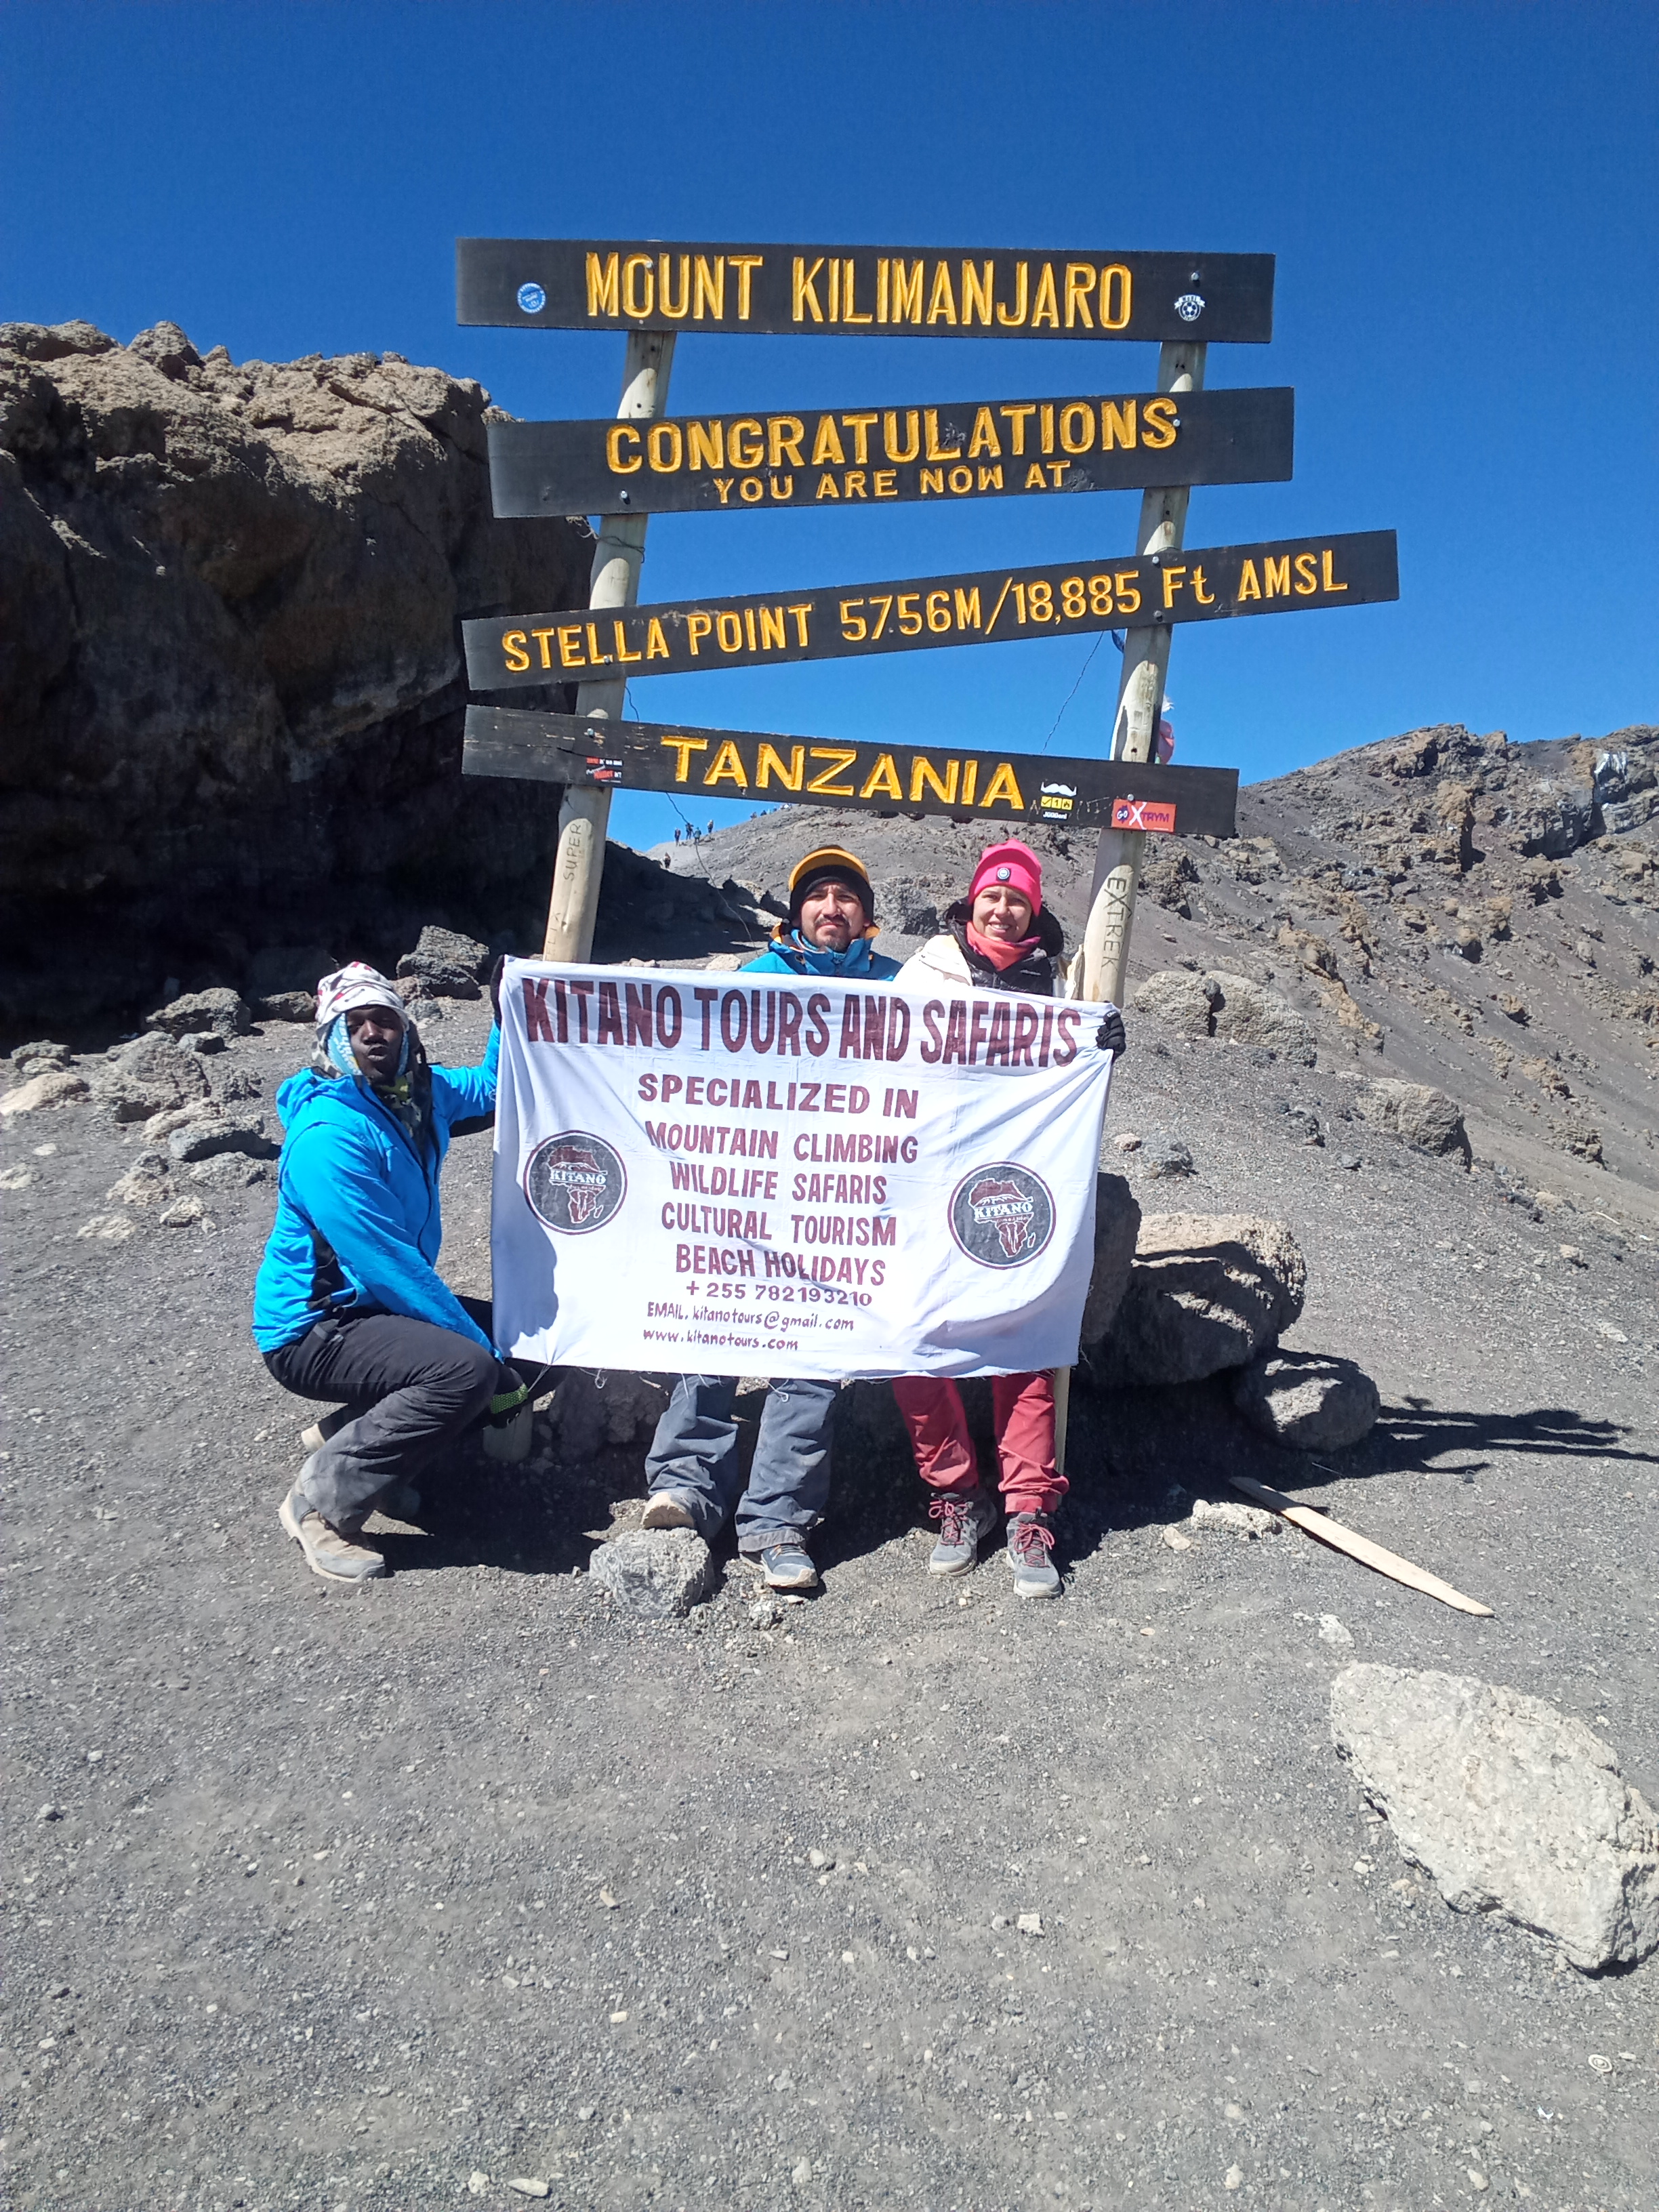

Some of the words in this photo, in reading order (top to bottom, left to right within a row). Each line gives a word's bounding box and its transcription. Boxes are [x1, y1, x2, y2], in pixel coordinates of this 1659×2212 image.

[586, 251, 764, 320] MOUNT
[793, 256, 1133, 330] KILIMANJARO
[606, 397, 1178, 473] CONGRATULATIONS
[713, 475, 794, 504] YOU
[817, 470, 897, 499] ARE
[920, 464, 1004, 495] NOW
[1025, 460, 1071, 489] AT
[502, 617, 671, 672] STELLA
[688, 603, 813, 655] POINT
[1162, 565, 1215, 609] Ft
[1237, 549, 1348, 602] AMSL
[661, 735, 1025, 810] TANZANIA
[562, 823, 582, 882] SUPER
[1101, 877, 1132, 972] EXTREK
[523, 977, 682, 1048] KITANO
[695, 988, 831, 1057] TOURS
[838, 994, 911, 1063] AND
[920, 999, 1082, 1068] SAFARIS
[638, 1073, 870, 1114] SPECIALIZED
[882, 1088, 919, 1120] IN
[644, 1120, 779, 1160] MOUNTAIN
[793, 1133, 918, 1164] CLIMBING
[550, 1170, 607, 1185] KITANO
[670, 1162, 779, 1200] WILDLIFE
[792, 1172, 888, 1206] SAFARIS
[661, 1202, 773, 1241] CULTURAL
[791, 1214, 897, 1246] TOURISM
[973, 1202, 1034, 1218] KITANO
[676, 1243, 756, 1277] BEACH
[764, 1250, 886, 1286] HOLIDAYS
[755, 1284, 872, 1307] 782193210
[642, 1328, 799, 1351] www.kitanotours.com
